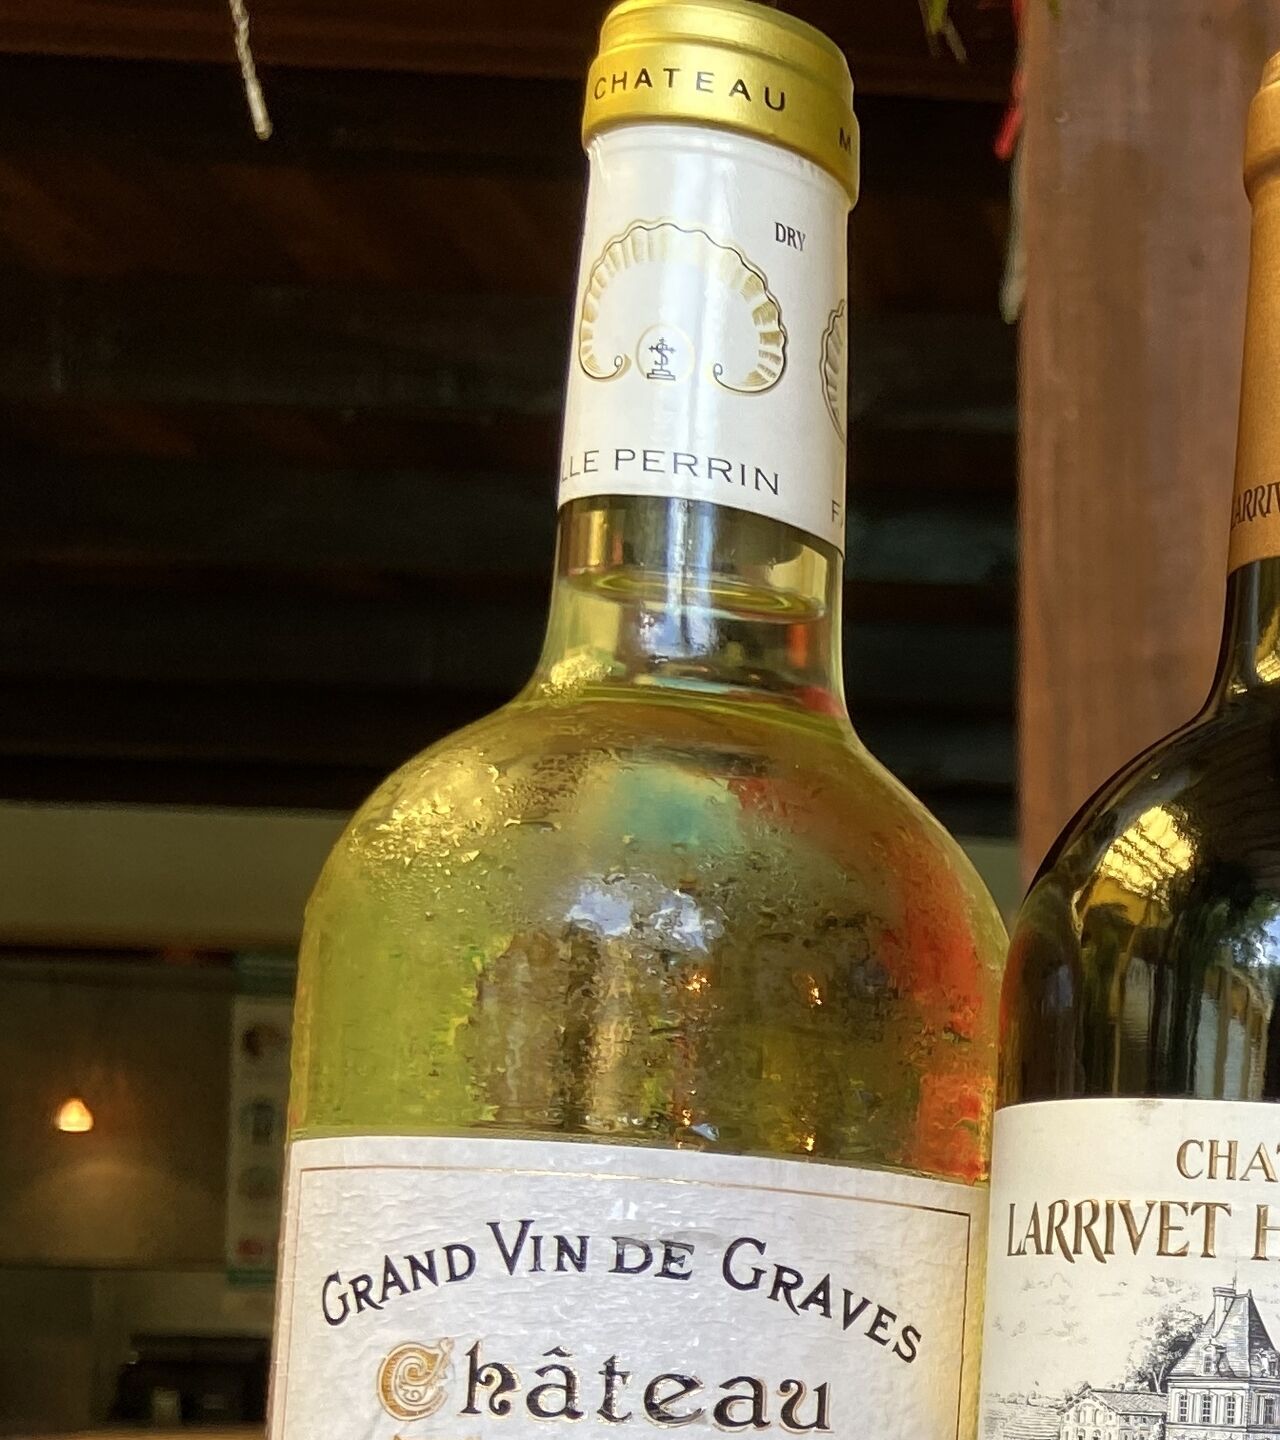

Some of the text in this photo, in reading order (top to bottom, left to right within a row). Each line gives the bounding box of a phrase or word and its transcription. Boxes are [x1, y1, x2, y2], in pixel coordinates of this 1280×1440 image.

[594, 67, 786, 111] CHATEAU
[774, 221, 806, 252] DRY
[614, 448, 780, 496] PERRIN
[1006, 1198, 1233, 1264] LARRIVET
[321, 1219, 924, 1366] GRAND VIN DE GRAVES
[376, 1336, 832, 1434] Château
